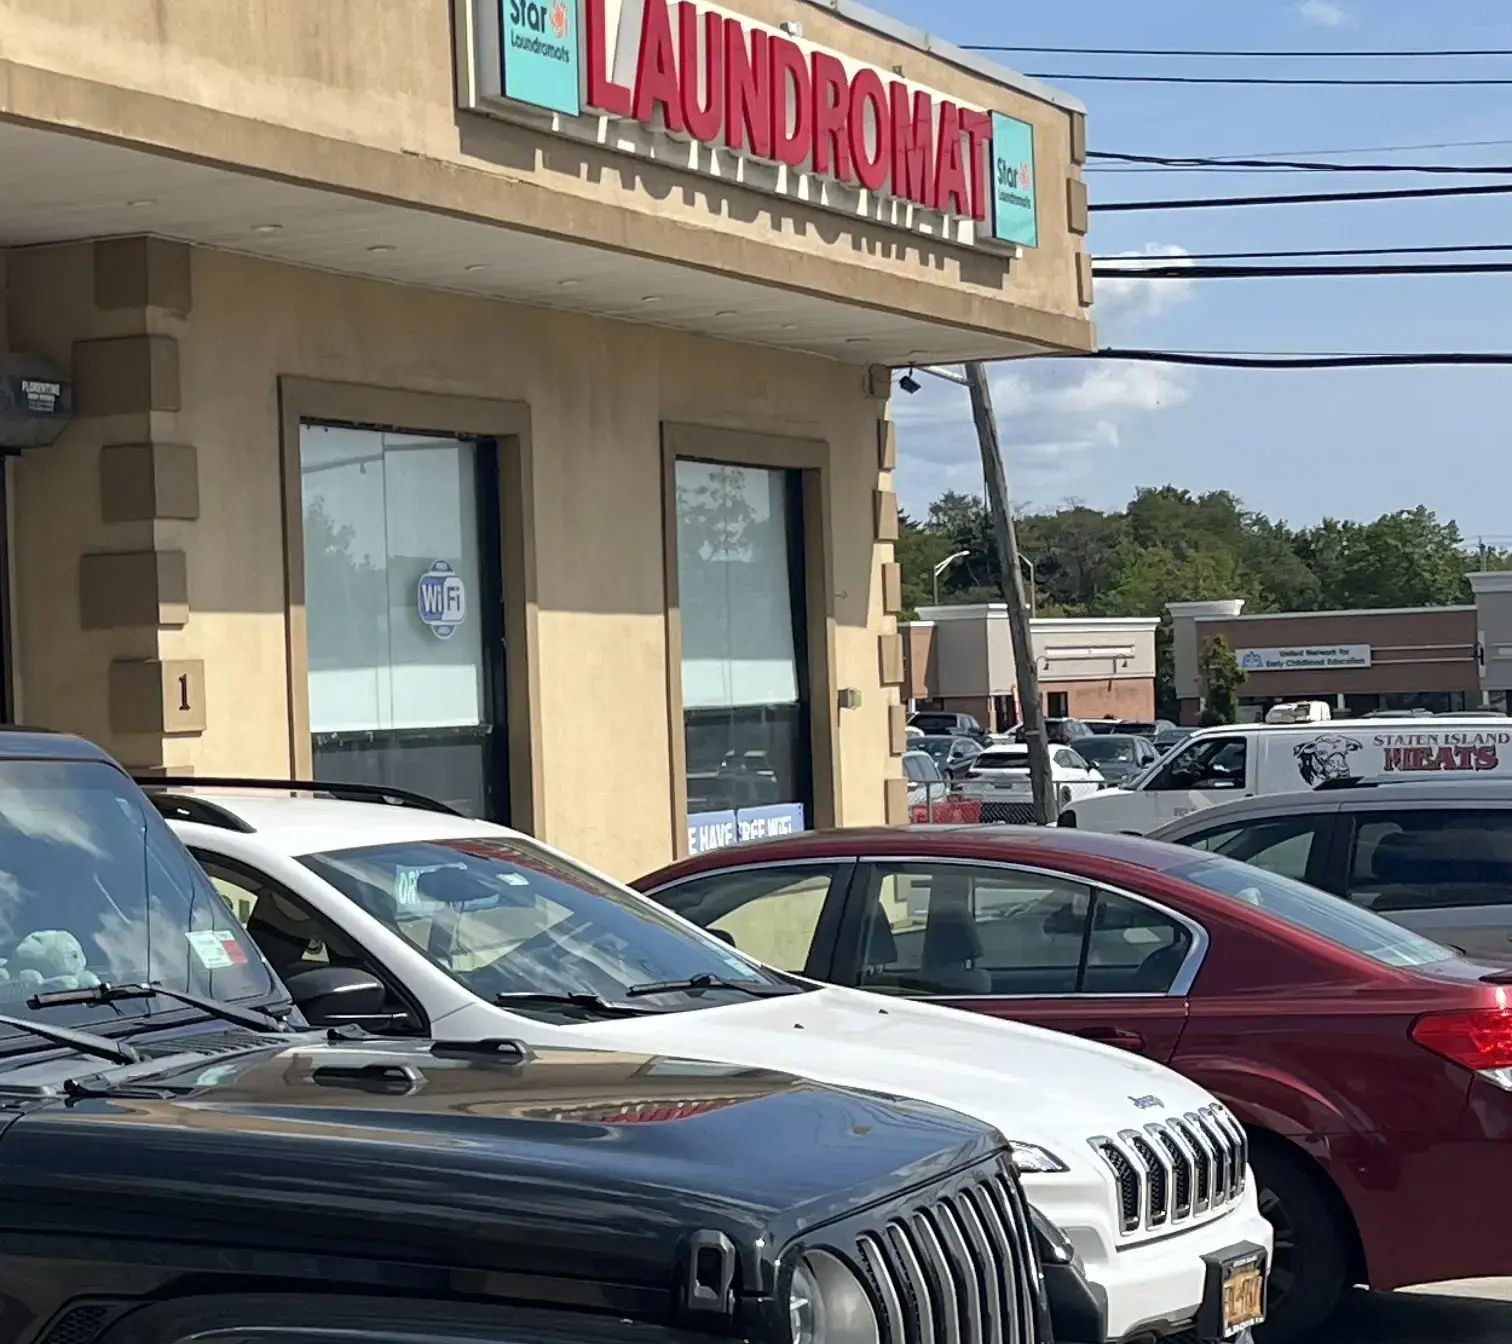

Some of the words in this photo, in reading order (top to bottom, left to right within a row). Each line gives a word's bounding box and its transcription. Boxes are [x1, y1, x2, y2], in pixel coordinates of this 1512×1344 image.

[510, 28, 570, 64] Laundromats
[997, 156, 1018, 188] Star
[421, 583, 461, 613] WiFi
[1266, 659, 1284, 668] Early
[1286, 658, 1325, 667] Childhood
[1327, 656, 1365, 665] Education
[1279, 649, 1304, 657] United
[178, 673, 191, 711] 1
[1373, 734, 1438, 746] STATEN
[1444, 733, 1511, 745] ISLAND
[1383, 745, 1499, 771] MEATS
[699, 822, 734, 852] HAVE
